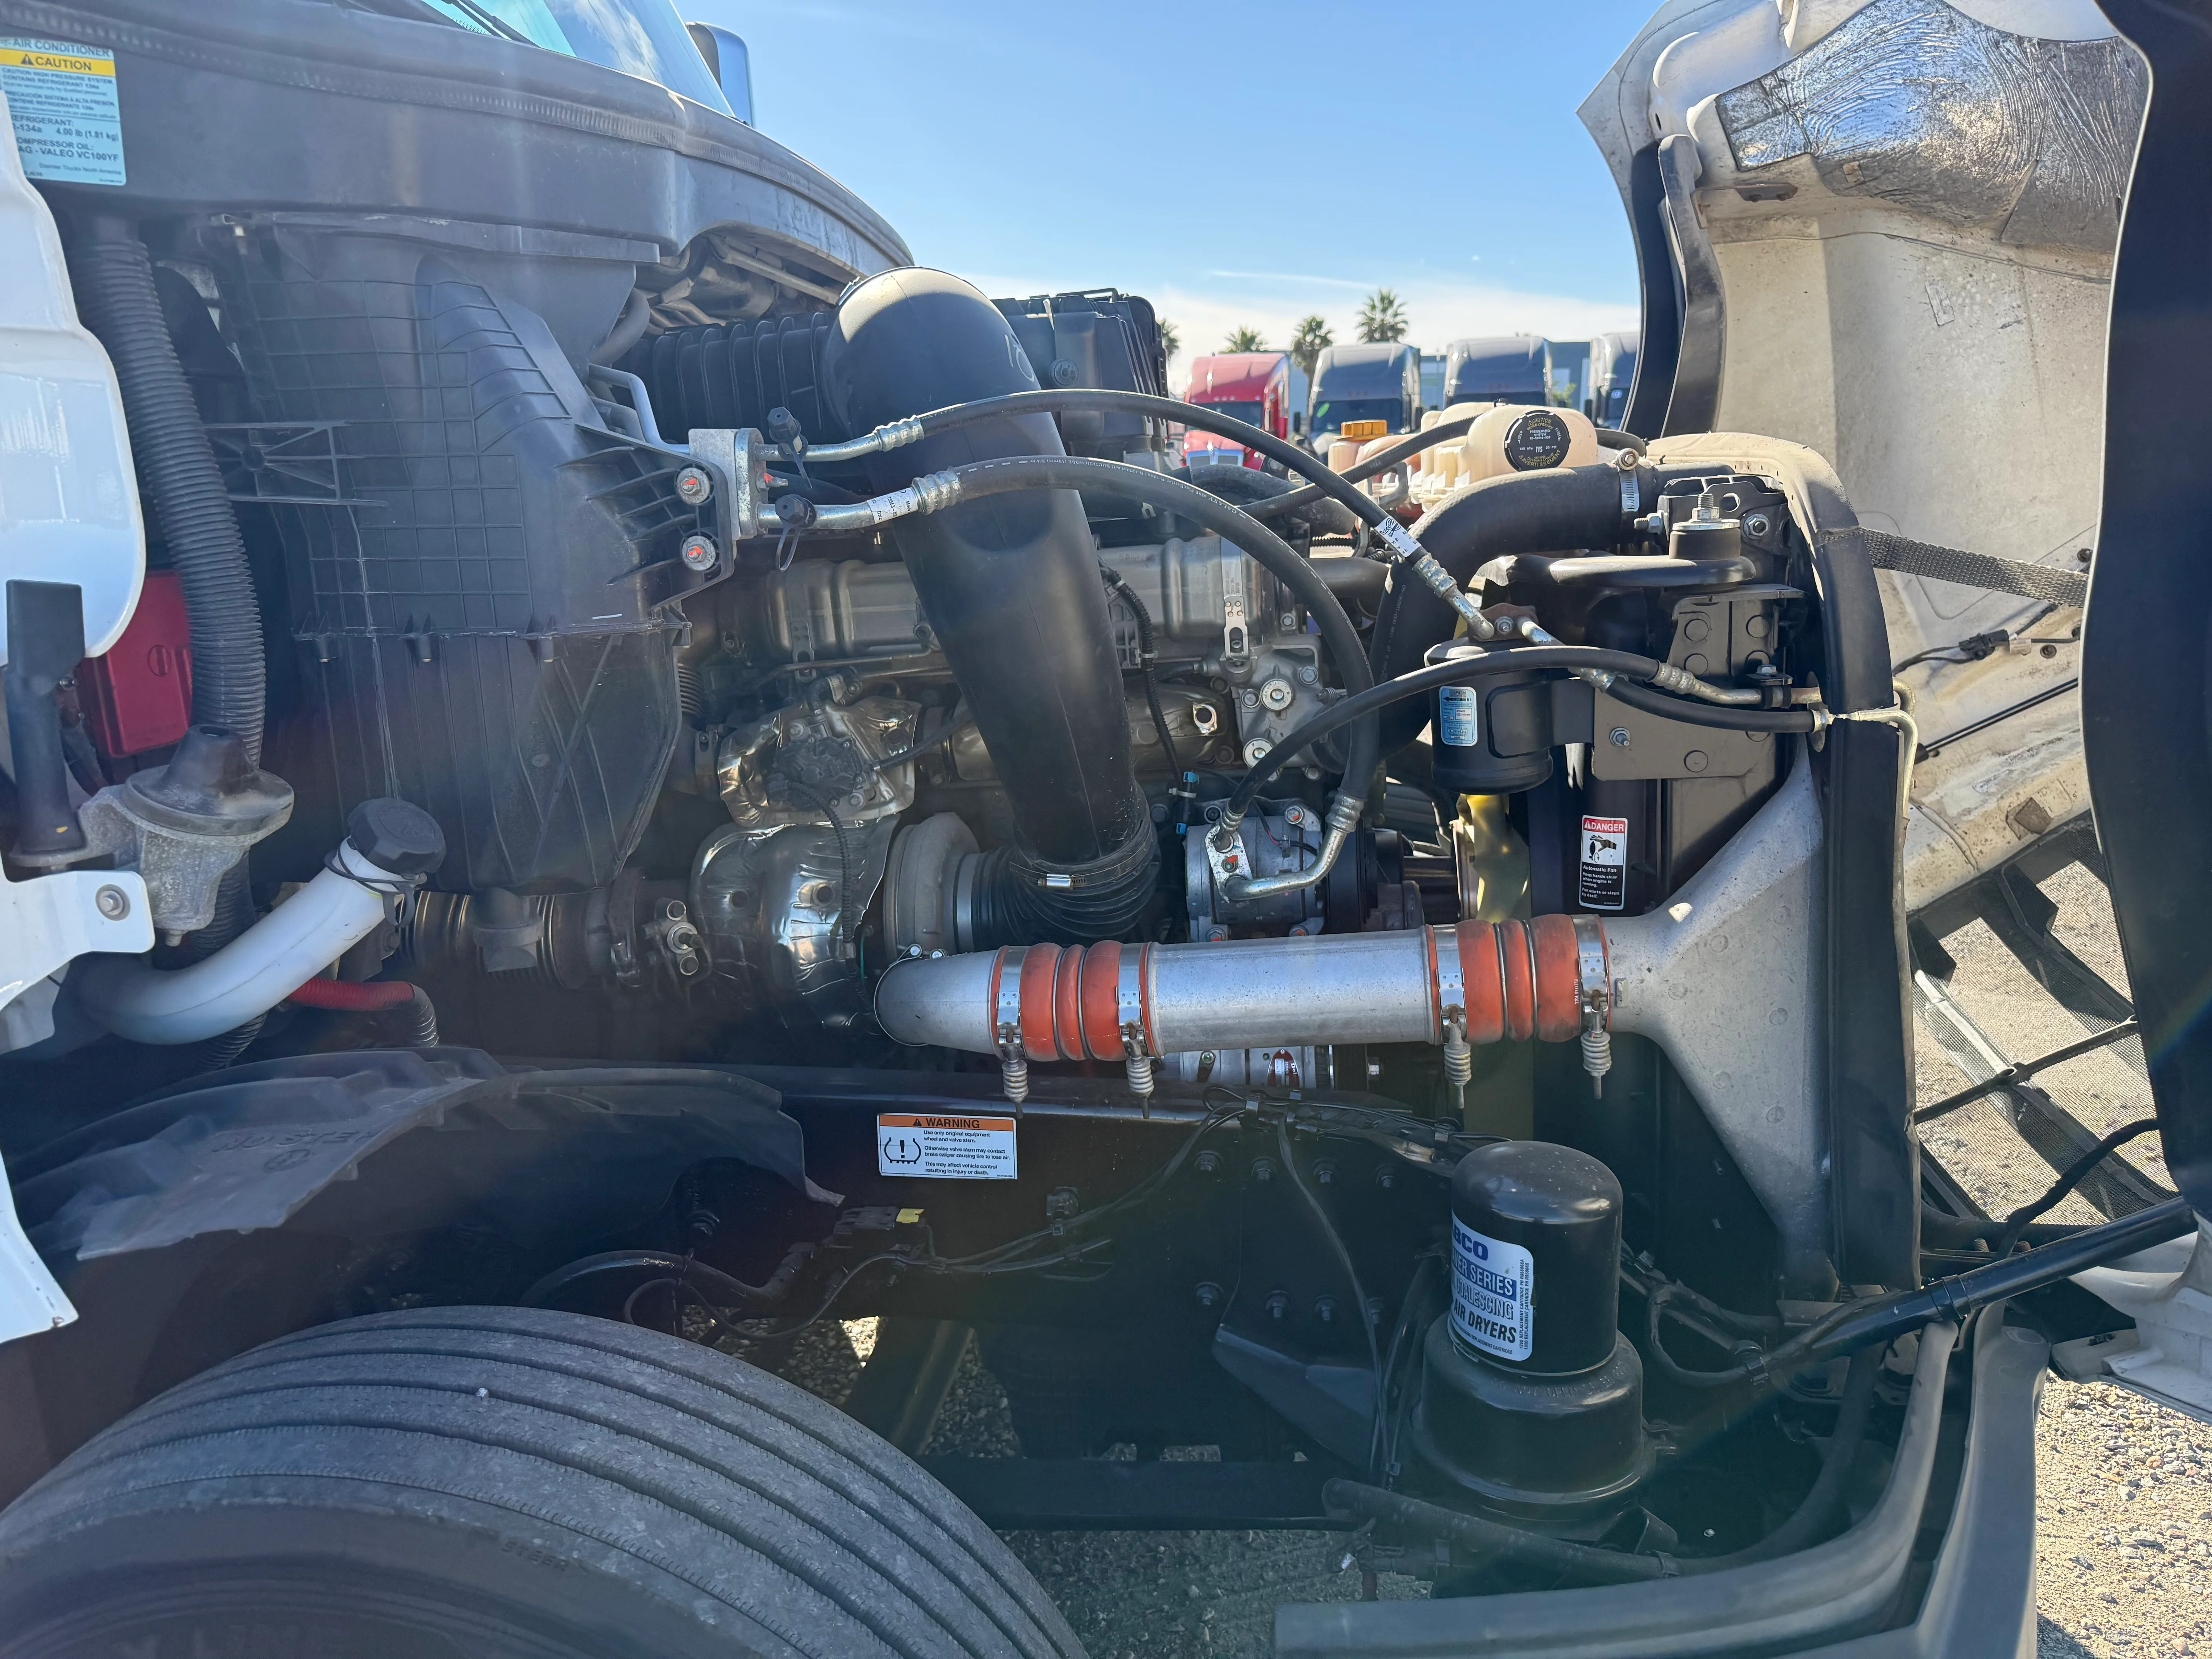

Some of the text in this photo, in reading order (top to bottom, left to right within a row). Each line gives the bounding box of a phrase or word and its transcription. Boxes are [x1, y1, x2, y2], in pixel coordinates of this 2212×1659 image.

[13, 39, 110, 57] AIR CONDITIONER
[35, 57, 92, 71] CAUTION
[38, 78, 83, 88] REFRIGERANT
[51, 73, 86, 82] PRESSURE
[56, 127, 73, 136] 4.00
[17, 137, 75, 149] OMPRESSOR
[18, 145, 33, 154] AG
[40, 148, 74, 158] VALEO
[76, 151, 119, 161] VC100YF
[1208, 498, 1237, 514] GALAXY
[1590, 823, 1624, 831] DANGER
[926, 1117, 980, 1129] WARNING
[1453, 1223, 1488, 1261] BCO
[1453, 1251, 1467, 1277] VER
[1470, 1264, 1513, 1296] SERIES
[1457, 1275, 1513, 1320] COALESCING
[1454, 1297, 1517, 1344] AIR DRYERS
[1493, 1345, 1513, 1355] CARTRIDGE
[501, 1540, 568, 1572] STEER
